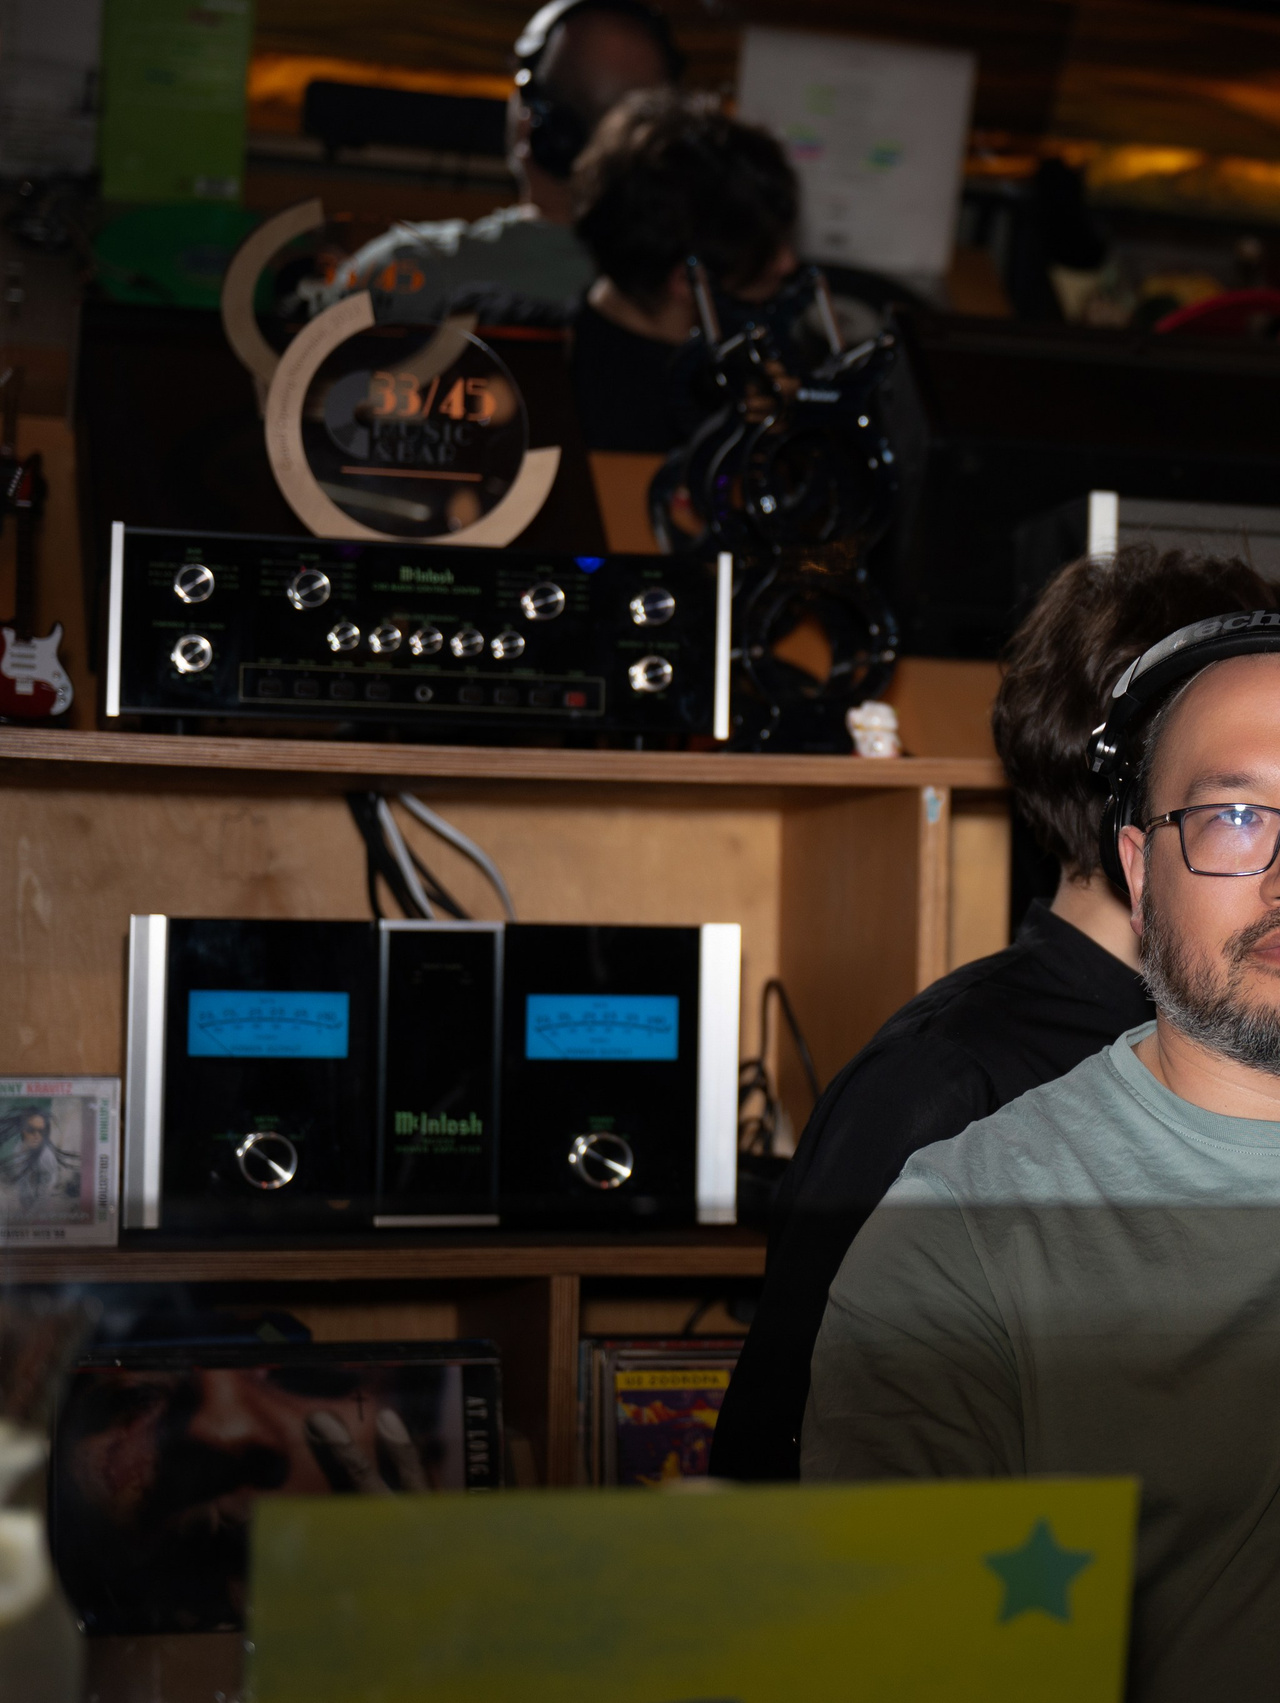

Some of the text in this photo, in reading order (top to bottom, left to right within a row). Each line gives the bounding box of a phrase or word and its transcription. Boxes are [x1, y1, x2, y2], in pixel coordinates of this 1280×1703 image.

[371, 371, 497, 421] 33/45
[373, 418, 473, 446] MUSIC
[394, 1111, 484, 1136] McIntosh
[465, 1396, 490, 1476] AT LONG
